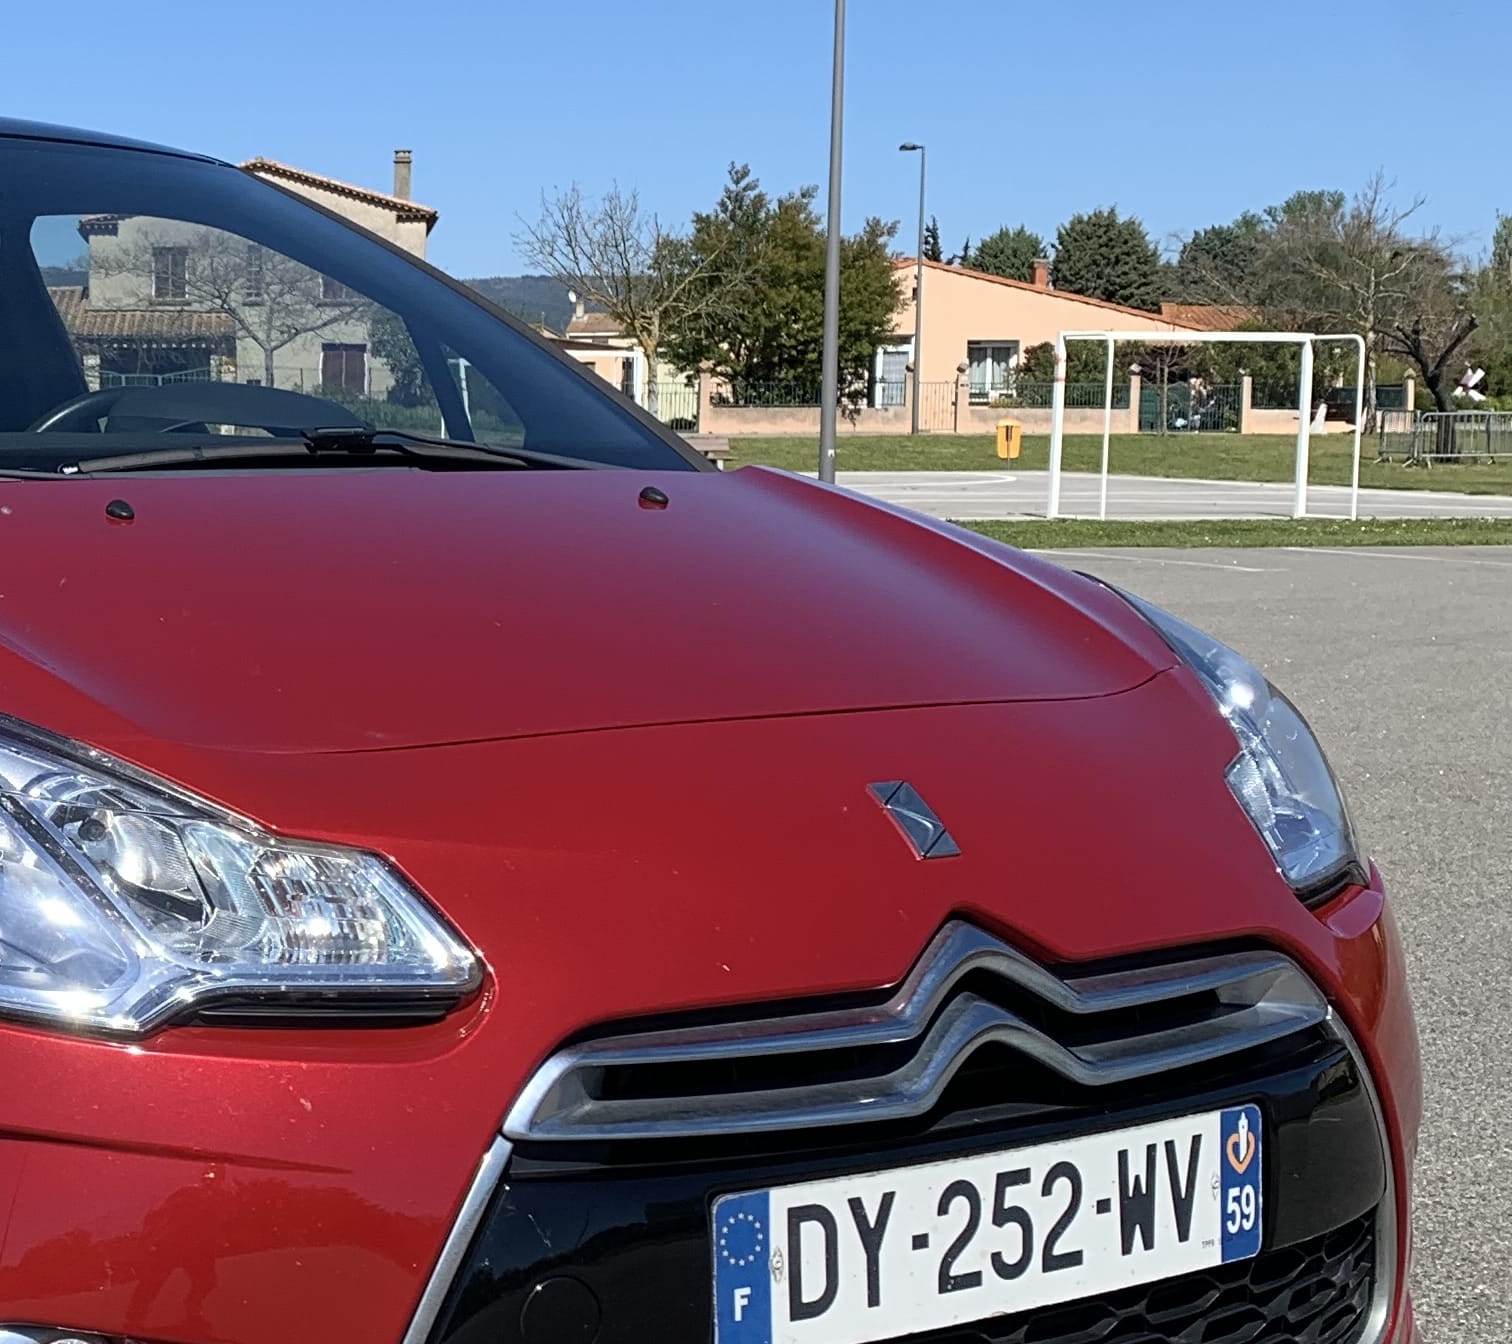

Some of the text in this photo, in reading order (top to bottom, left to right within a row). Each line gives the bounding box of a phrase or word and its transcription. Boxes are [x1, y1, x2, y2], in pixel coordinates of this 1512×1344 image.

[787, 1133, 1203, 1323] DY-252-WV
[1226, 1183, 1256, 1234] 59
[733, 1286, 752, 1323] F
